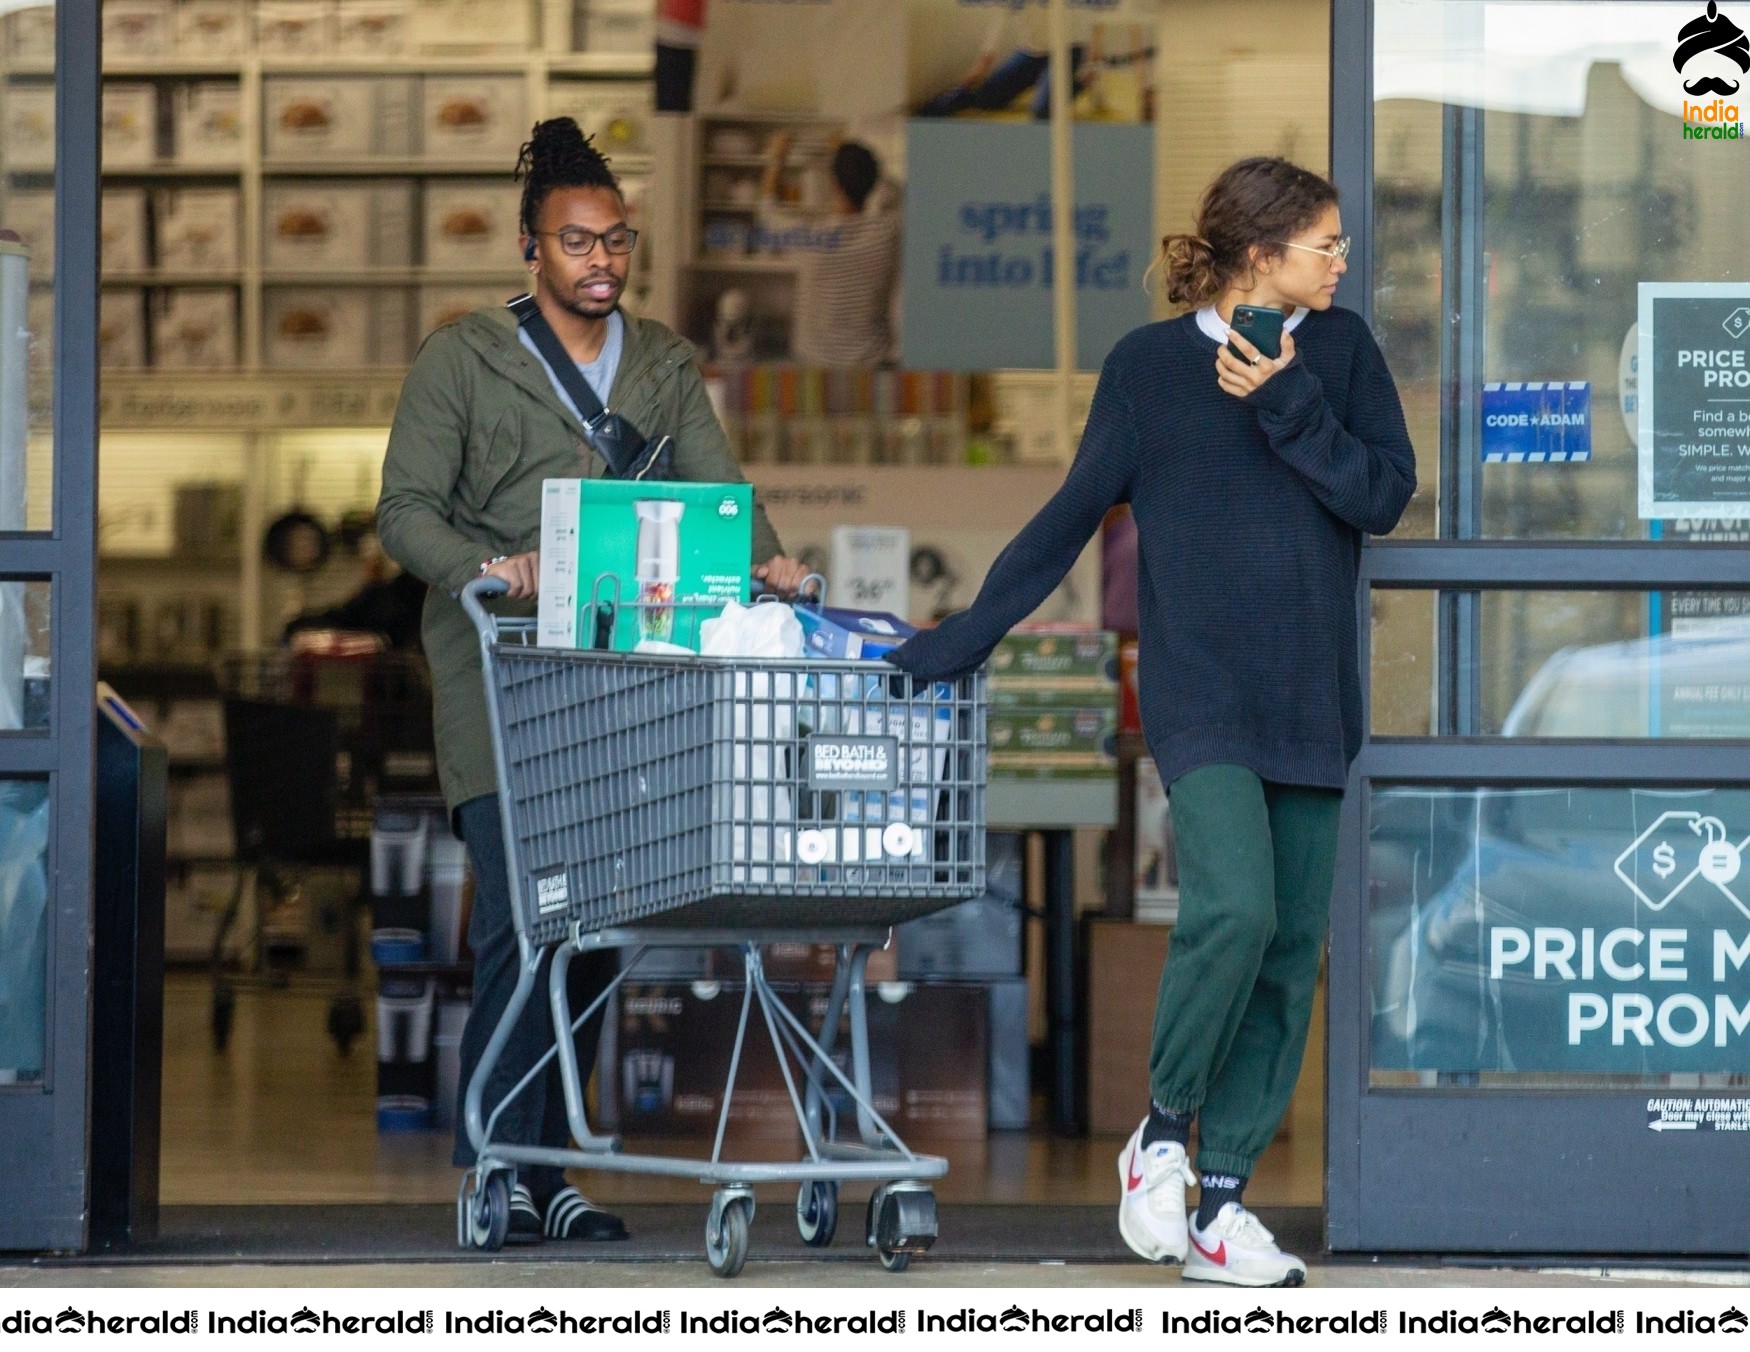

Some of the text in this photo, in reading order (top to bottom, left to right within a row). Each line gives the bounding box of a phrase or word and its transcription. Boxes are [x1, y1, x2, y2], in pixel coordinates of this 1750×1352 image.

[937, 243, 1033, 286] into
[1678, 350, 1745, 367] PRICE
[1693, 409, 1723, 422] Find
[1726, 412, 1735, 422] a
[1678, 444, 1733, 457] SIMPLE.
[1696, 464, 1707, 472] We
[1709, 464, 1726, 473] price
[1711, 474, 1746, 483] and major
[1671, 599, 1701, 613] EVERY
[1703, 599, 1721, 613] TIME
[1724, 599, 1740, 613] YOU
[814, 744, 887, 760] BED BATH &
[1490, 927, 1688, 983] PRICE
[1647, 1098, 1693, 1112] CAUTION:
[1661, 1110, 1682, 1121] Door
[1685, 1111, 1704, 1123] may
